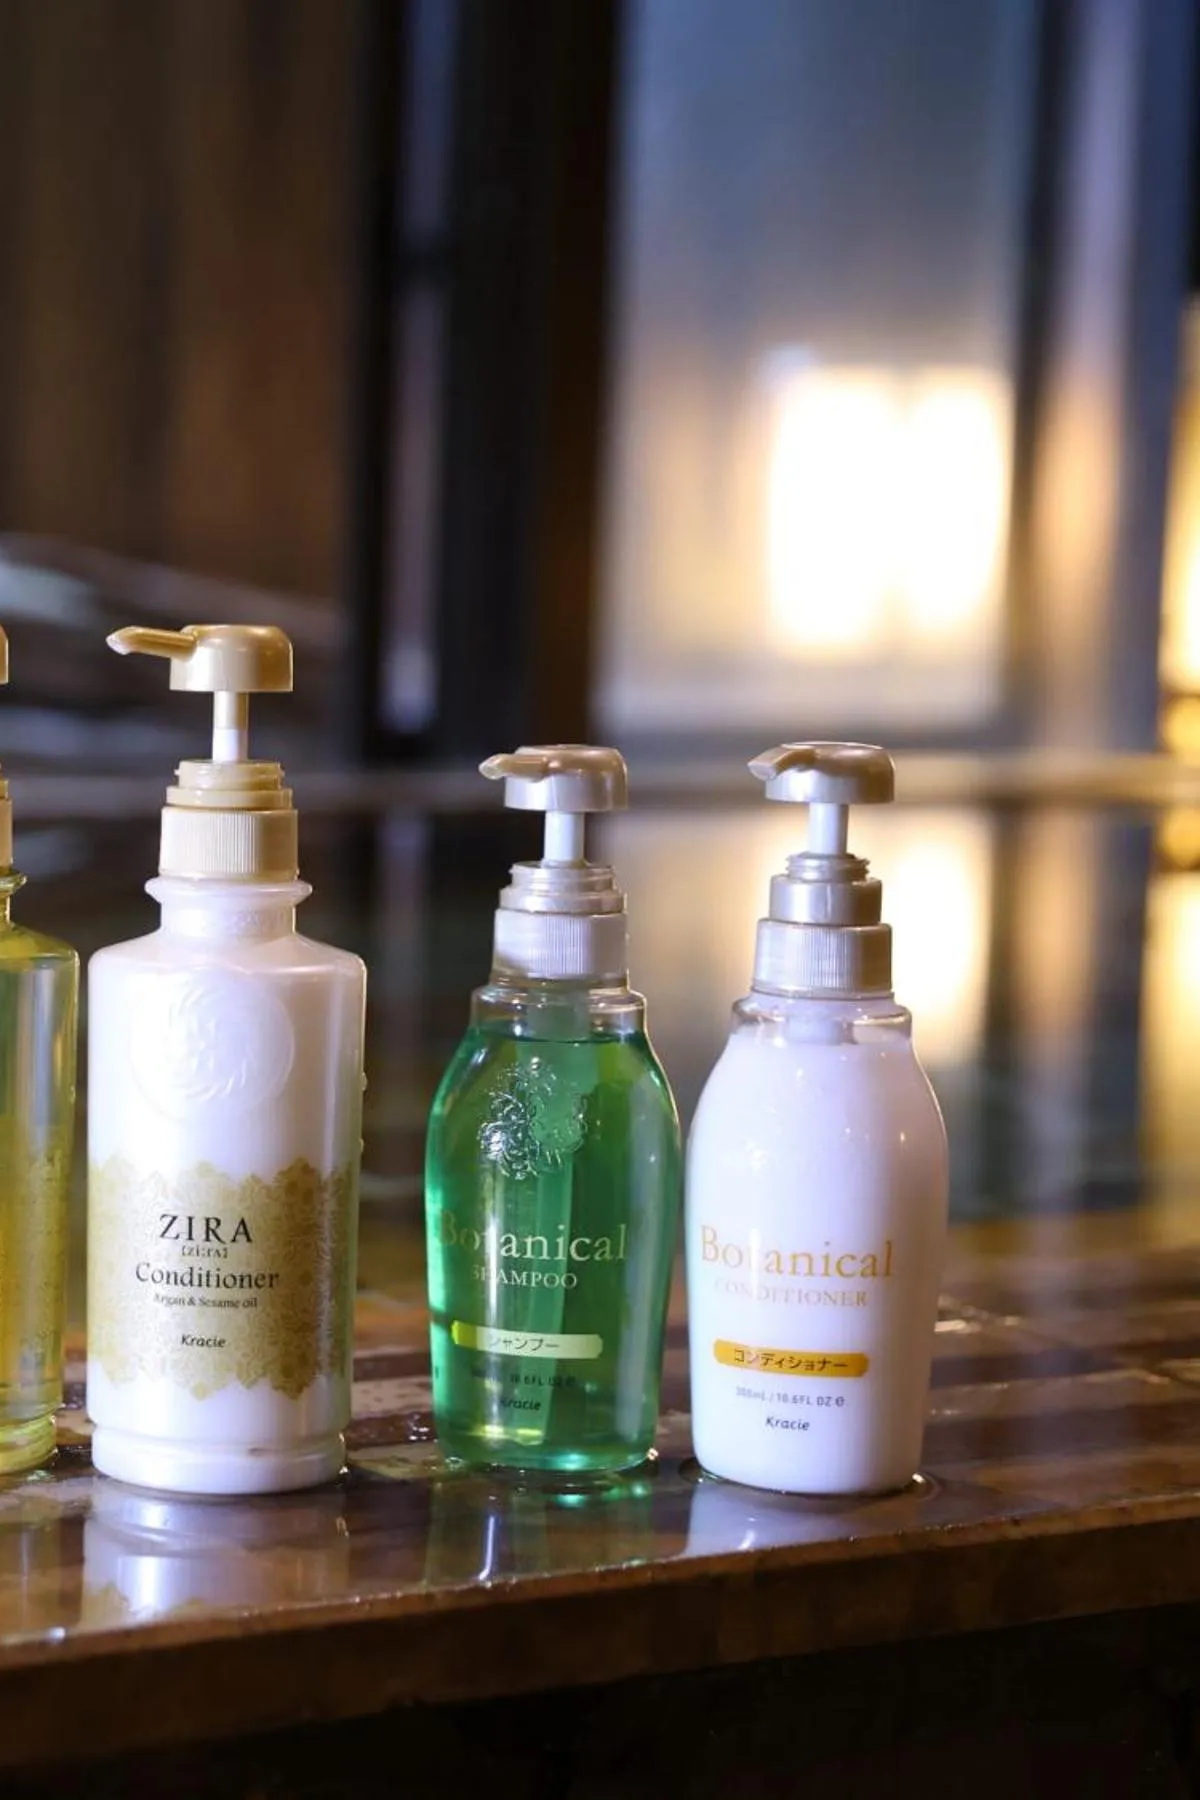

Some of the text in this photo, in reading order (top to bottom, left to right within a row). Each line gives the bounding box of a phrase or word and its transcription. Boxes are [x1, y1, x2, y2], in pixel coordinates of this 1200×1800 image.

[159, 1214, 253, 1244] ZIRA
[440, 1210, 628, 1262] Boanical
[136, 1262, 280, 1289] Conditioner
[187, 1296, 197, 1306] &
[199, 1296, 240, 1309] Sesame
[242, 1296, 258, 1308] oil
[181, 1334, 226, 1348] Kracie
[734, 1348, 849, 1372] コンディショナー
[765, 1416, 811, 1431] Kracie
